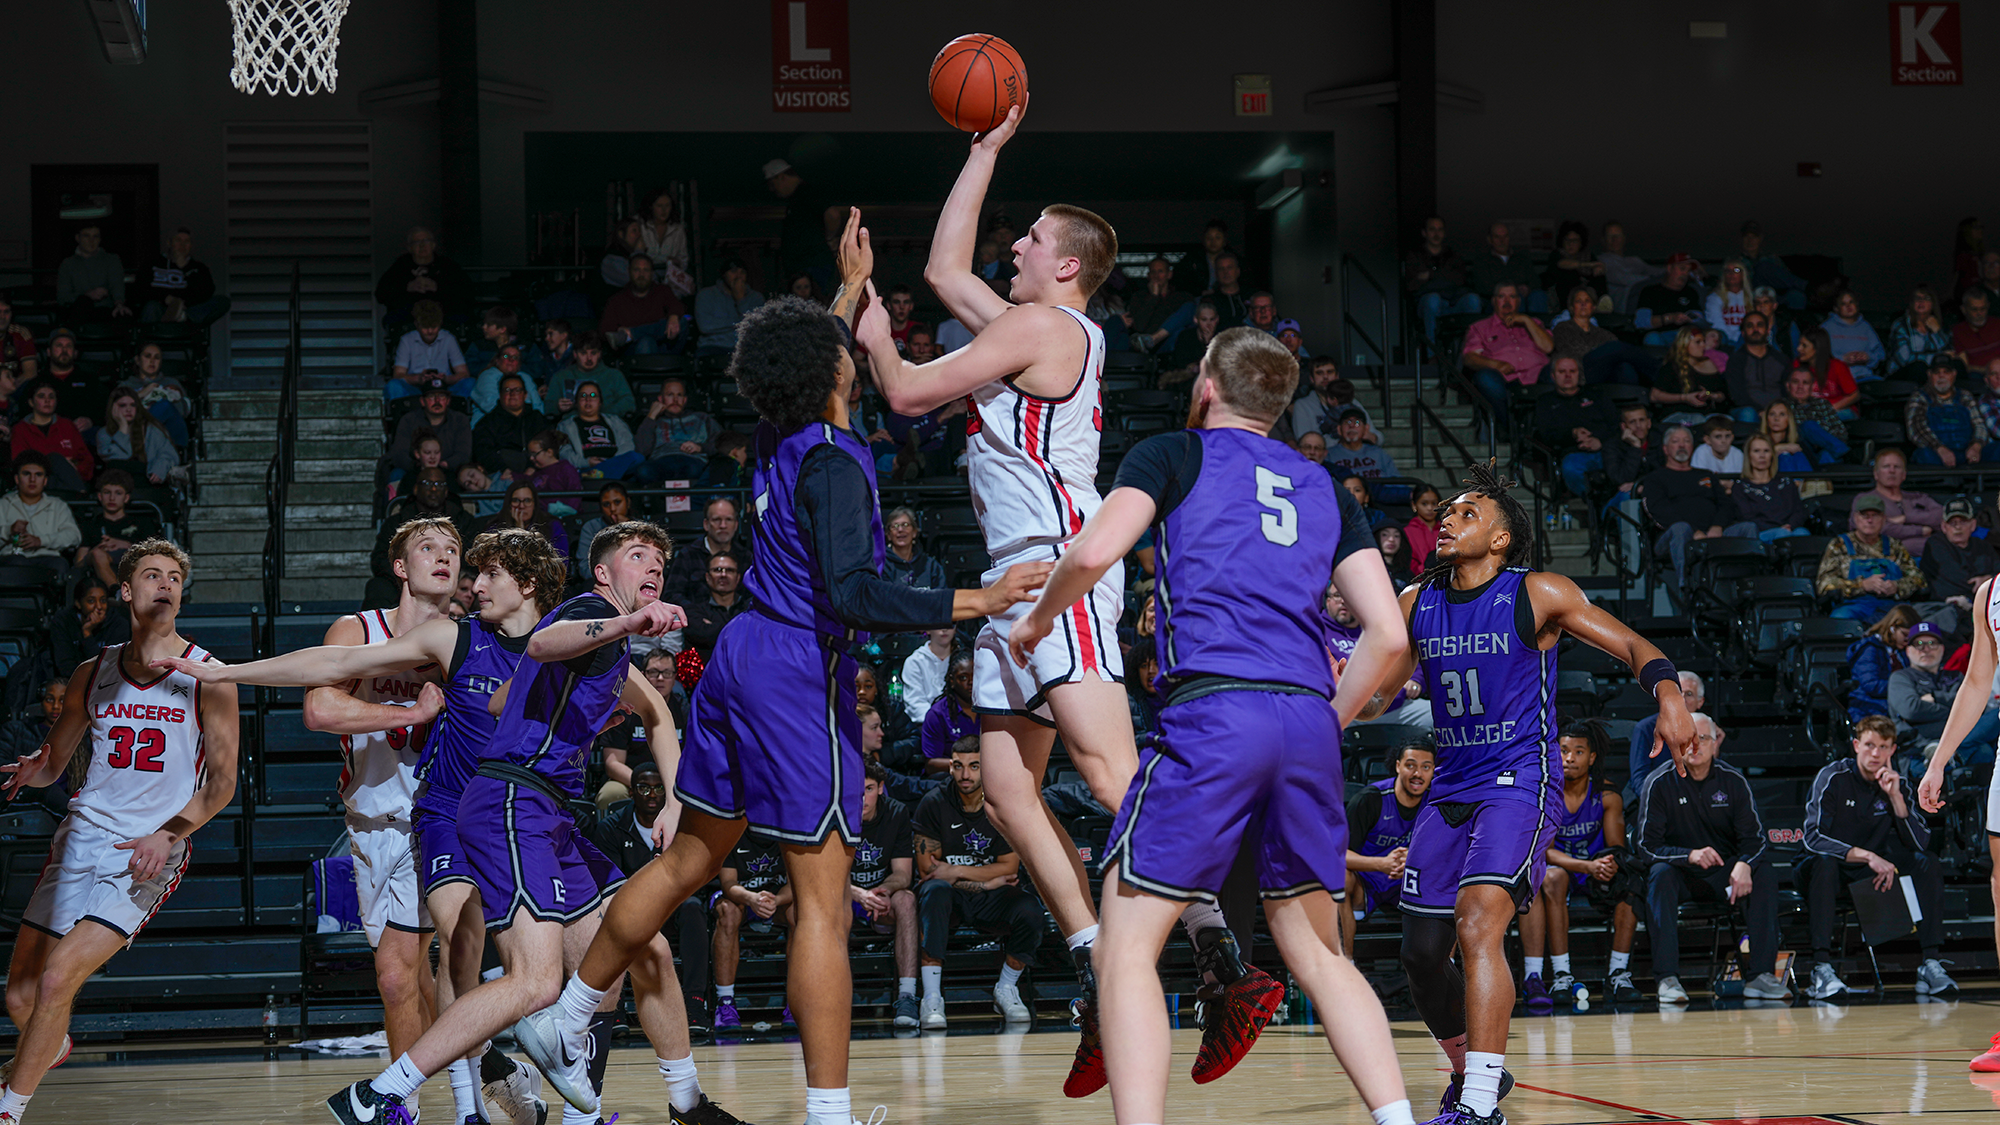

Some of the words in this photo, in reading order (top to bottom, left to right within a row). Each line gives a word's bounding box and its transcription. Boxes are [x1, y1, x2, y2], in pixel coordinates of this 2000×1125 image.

[788, 2, 831, 61] L
[1899, 5, 1952, 64] K
[780, 64, 842, 80] Section
[1898, 66, 1957, 82] Section
[774, 91, 850, 107] VISITORS
[1242, 93, 1267, 113] EXIT
[1255, 464, 1299, 548] 5
[1417, 632, 1510, 661] GOSHEN
[372, 676, 424, 698] LANC
[1440, 667, 1485, 718] 31
[95, 703, 186, 723] LANCERS
[1435, 720, 1516, 748] COLLEGE
[108, 726, 166, 772] 32
[1558, 820, 1601, 837] OSHEN
[1768, 828, 1804, 843] GRA
[431, 855, 452, 877] G
[861, 850, 872, 862] G
[1402, 867, 1422, 896] G
